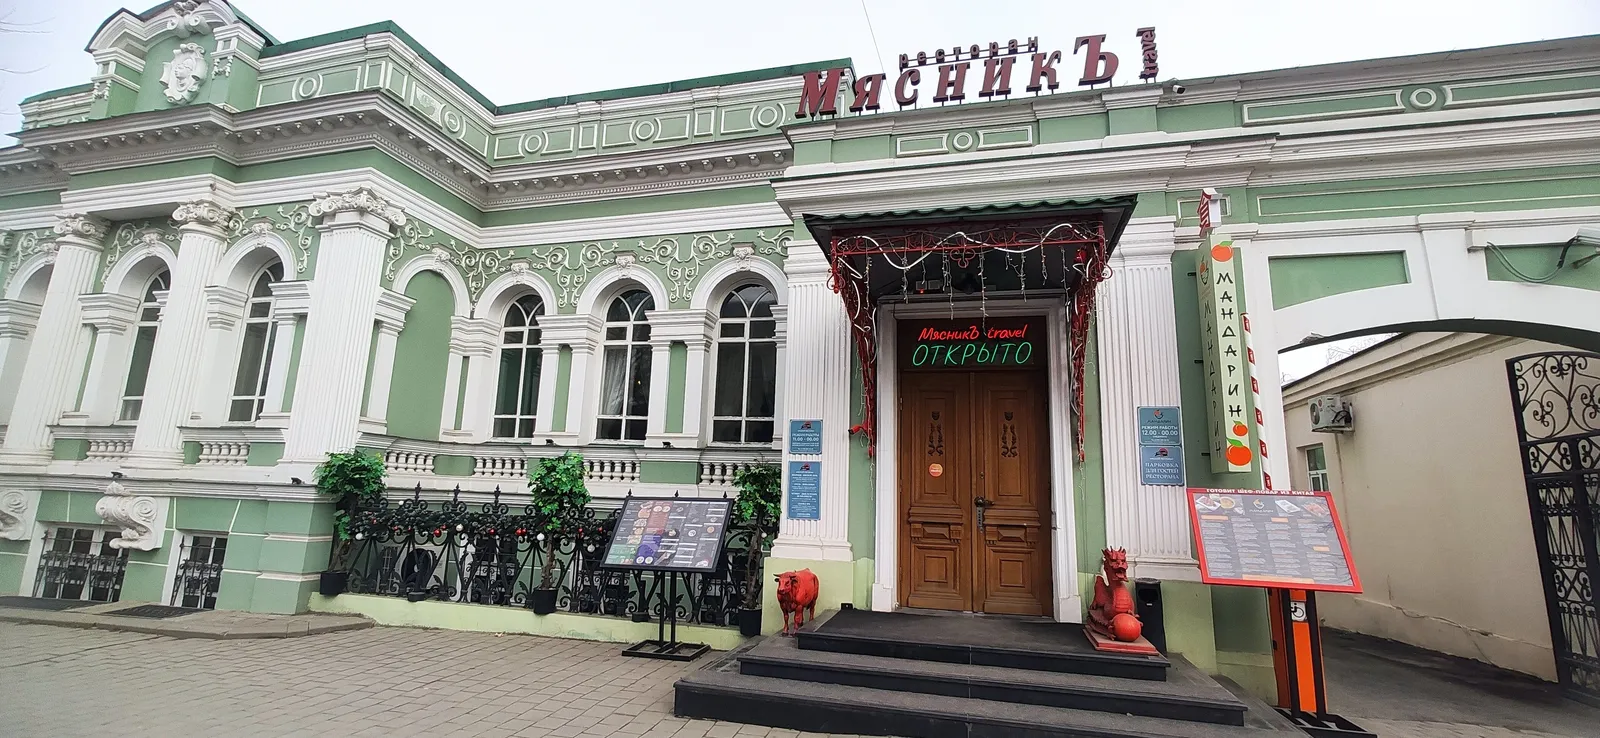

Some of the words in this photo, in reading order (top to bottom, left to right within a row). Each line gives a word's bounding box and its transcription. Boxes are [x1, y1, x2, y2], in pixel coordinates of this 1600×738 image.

[899, 36, 1038, 69] ресторан
[1136, 26, 1159, 79] travel
[987, 324, 1028, 339] travel
[1216, 272, 1242, 418] МАНДАРИН
[912, 342, 1032, 366] ОТКРЫТО
[1204, 300, 1222, 459] МАНДАРИН
